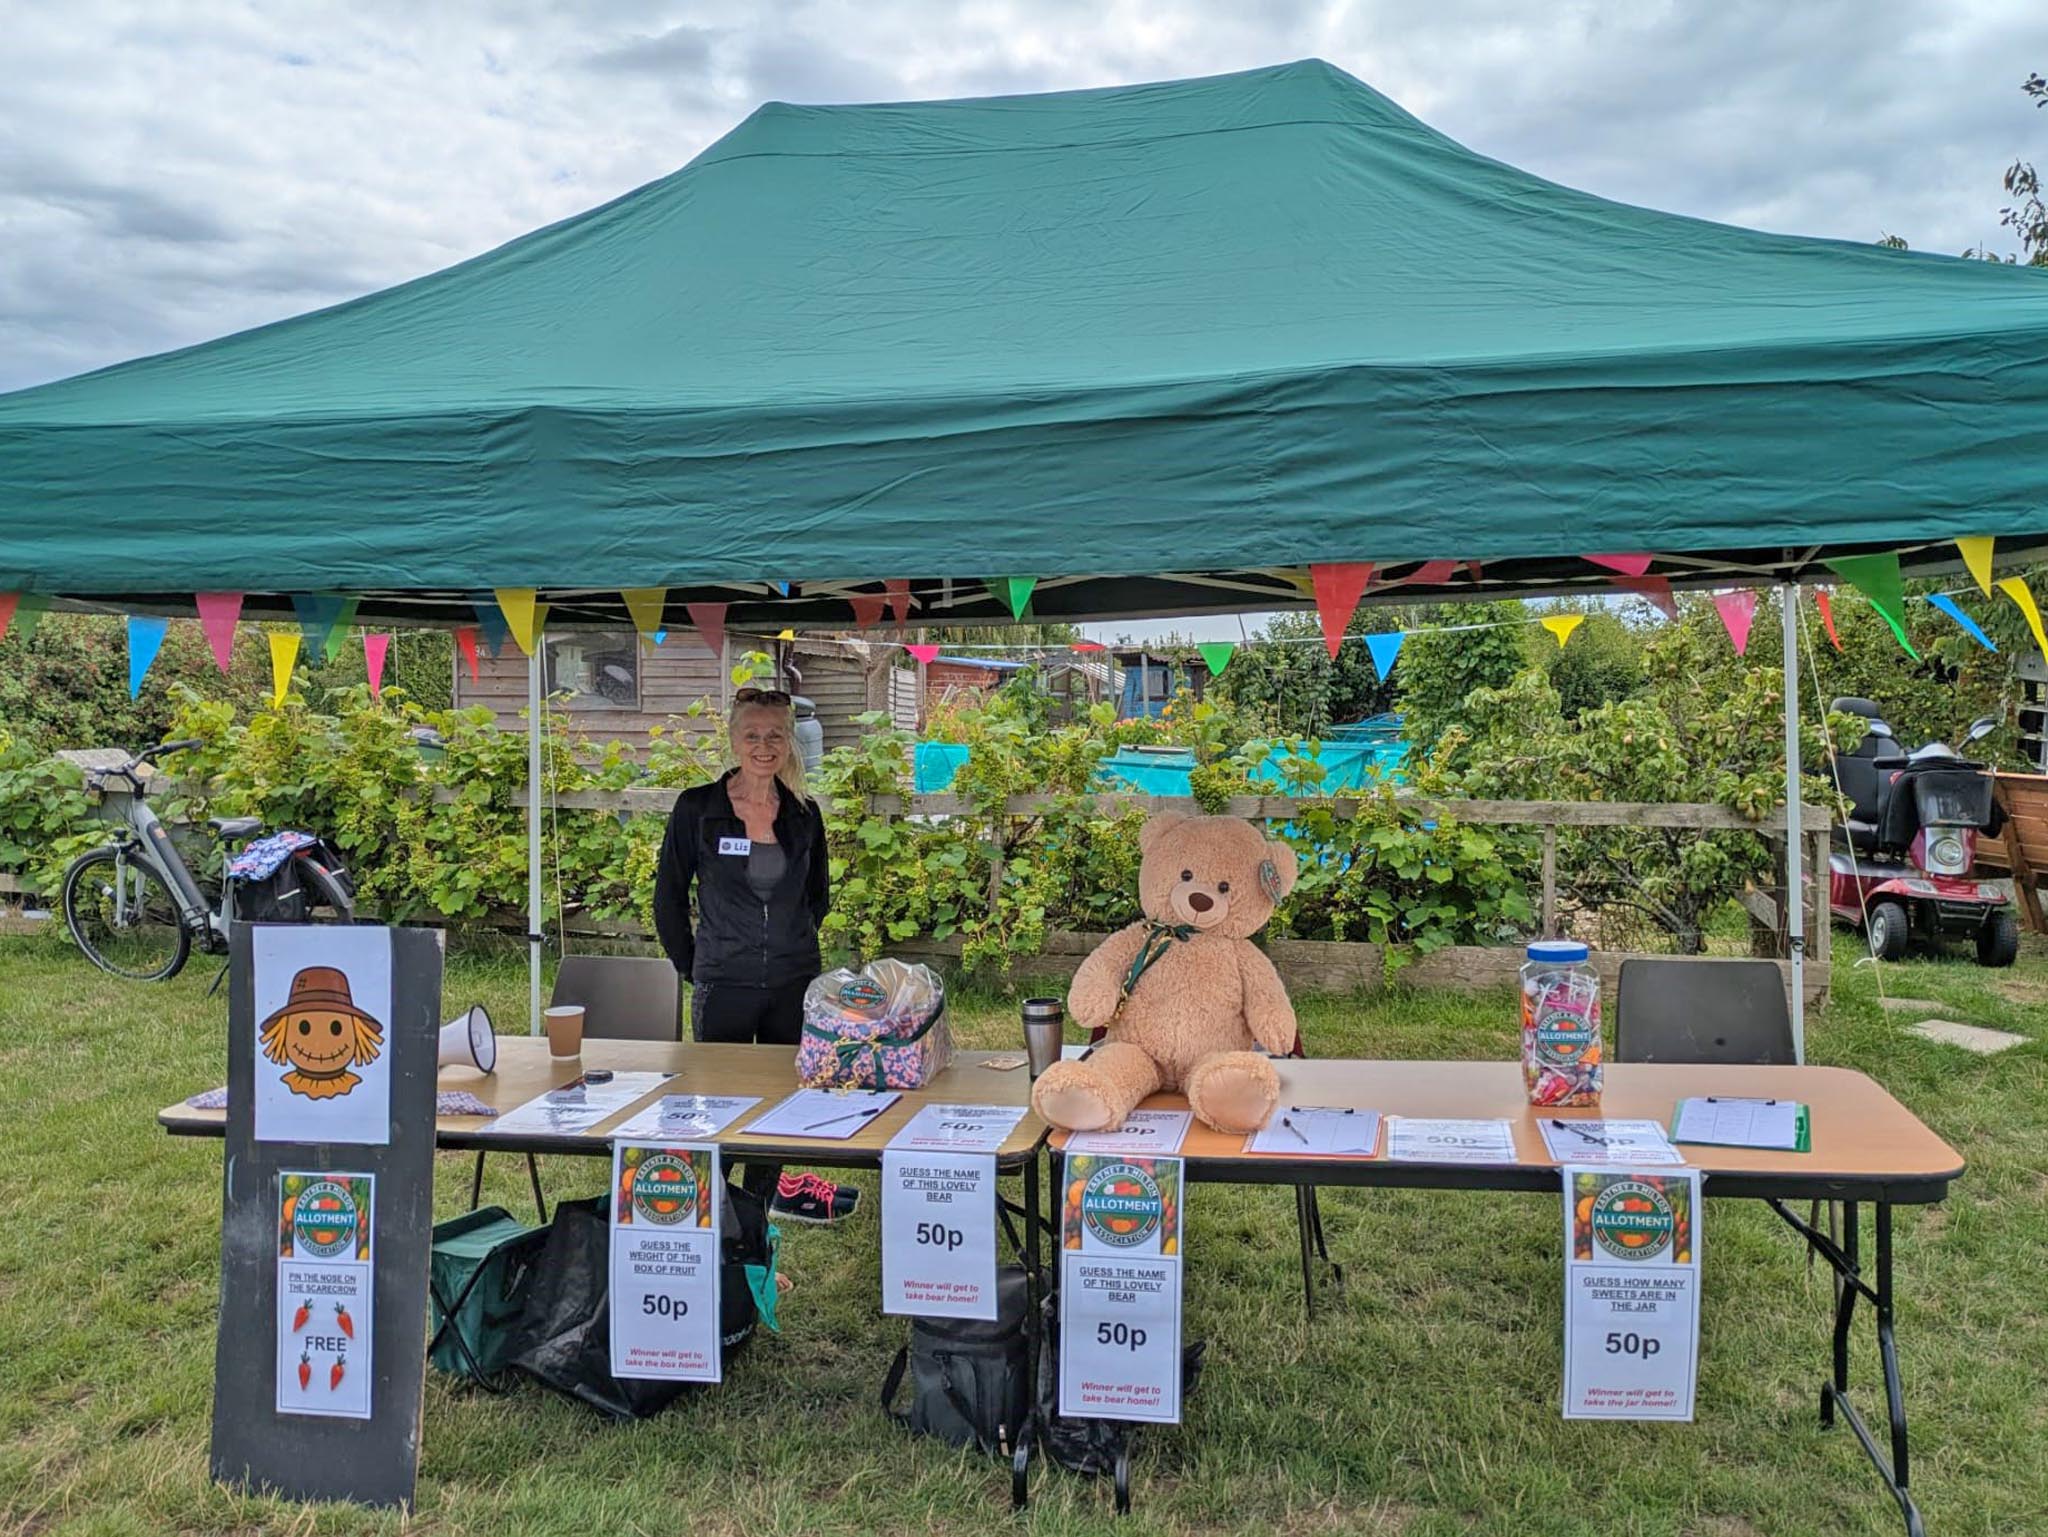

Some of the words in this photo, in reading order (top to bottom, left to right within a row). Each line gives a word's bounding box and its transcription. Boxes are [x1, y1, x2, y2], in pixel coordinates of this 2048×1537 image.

[939, 1122, 984, 1131] 50p
[900, 1168, 931, 1177] GUESS
[933, 1169, 952, 1178] THE
[954, 1170, 981, 1180] NAME
[636, 1183, 694, 1195] ALLOTMENT
[903, 1179, 916, 1189] OF
[919, 1180, 939, 1190] THIS
[941, 1181, 977, 1191] LOVELY
[927, 1192, 953, 1202] BEAR
[1086, 1198, 1159, 1212] ALLOTMENT
[297, 1213, 353, 1224] ALLOTMENT
[1595, 1214, 1669, 1227] ALLOTMENT
[916, 1222, 964, 1252] 50p
[640, 1240, 671, 1250] GUESS
[673, 1241, 691, 1252] THE
[629, 1251, 664, 1262] WEIGHT
[667, 1252, 679, 1262] OF
[681, 1253, 701, 1264] THIS
[634, 1264, 653, 1274] BOX
[655, 1265, 667, 1274] OF
[670, 1266, 696, 1276] FRUIT
[1080, 1266, 1113, 1277] GUESS
[1116, 1268, 1135, 1278] THE
[1138, 1269, 1167, 1280] NAME
[289, 1272, 301, 1281] PIN
[304, 1273, 318, 1282] THE
[320, 1274, 342, 1283] NOSE
[344, 1274, 356, 1284] ON
[1583, 1276, 1621, 1287] GUESS
[1624, 1278, 1650, 1288] HOW
[1653, 1279, 1686, 1289] MANY
[289, 1284, 304, 1293] THE
[306, 1284, 357, 1295] SCARECROW
[904, 1280, 934, 1290] Winner
[953, 1284, 968, 1293] get
[970, 1284, 979, 1292] to
[1083, 1278, 1097, 1288] OF
[1100, 1279, 1121, 1290] THIS
[1124, 1281, 1162, 1292] LOVELY
[947, 1294, 978, 1303] home!!
[1109, 1292, 1136, 1303] BEAR
[1592, 1289, 1637, 1299] SWEETS
[1640, 1291, 1662, 1301] ARE
[1665, 1291, 1677, 1301] IN
[643, 1294, 688, 1321] 50p
[1611, 1301, 1632, 1312] THE
[1634, 1302, 1657, 1312] JAR
[1097, 1322, 1147, 1352] 50p
[305, 1336, 347, 1352] FREE
[1605, 1332, 1661, 1360] 50p
[630, 1348, 660, 1357] Winner
[678, 1352, 692, 1360] get
[678, 1361, 708, 1369] home!!
[1081, 1382, 1114, 1392] Winner
[1117, 1384, 1133, 1393] will
[1134, 1386, 1149, 1395] get
[1152, 1386, 1161, 1395] to
[1588, 1388, 1624, 1396] Winner
[1645, 1390, 1661, 1398] get
[1082, 1393, 1102, 1402] take
[1104, 1395, 1125, 1404] bear
[1127, 1396, 1160, 1406] home!!
[1624, 1400, 1640, 1408] jar
